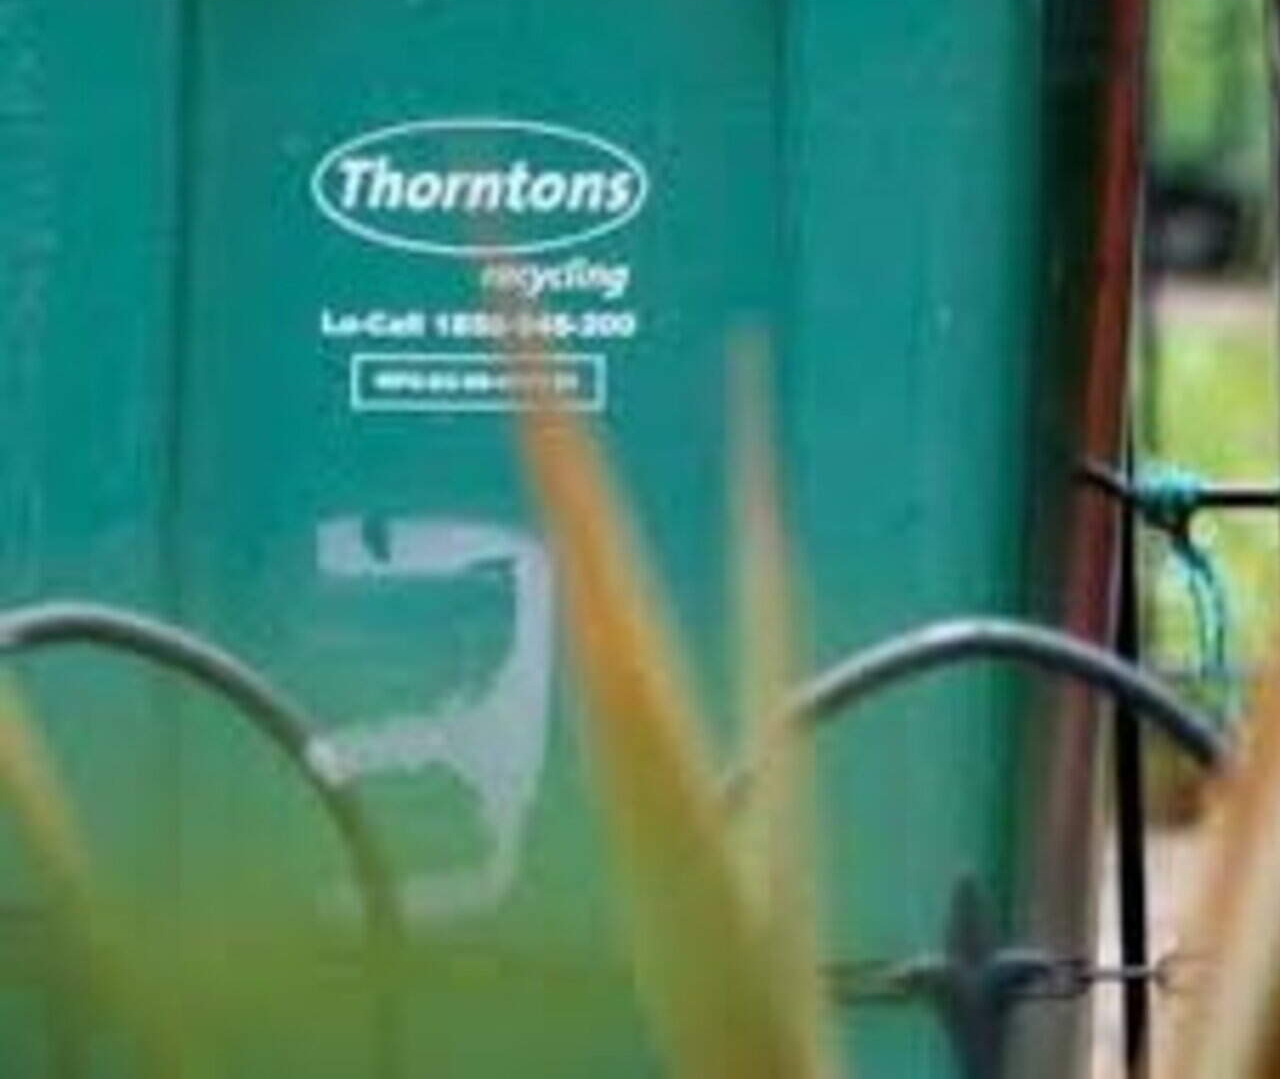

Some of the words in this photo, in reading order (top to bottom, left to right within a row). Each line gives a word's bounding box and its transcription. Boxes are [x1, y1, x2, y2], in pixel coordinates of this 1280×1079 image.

[339, 157, 633, 211] Thorntons
[481, 258, 630, 299] recycling
[321, 308, 425, 337] Lo-Call
